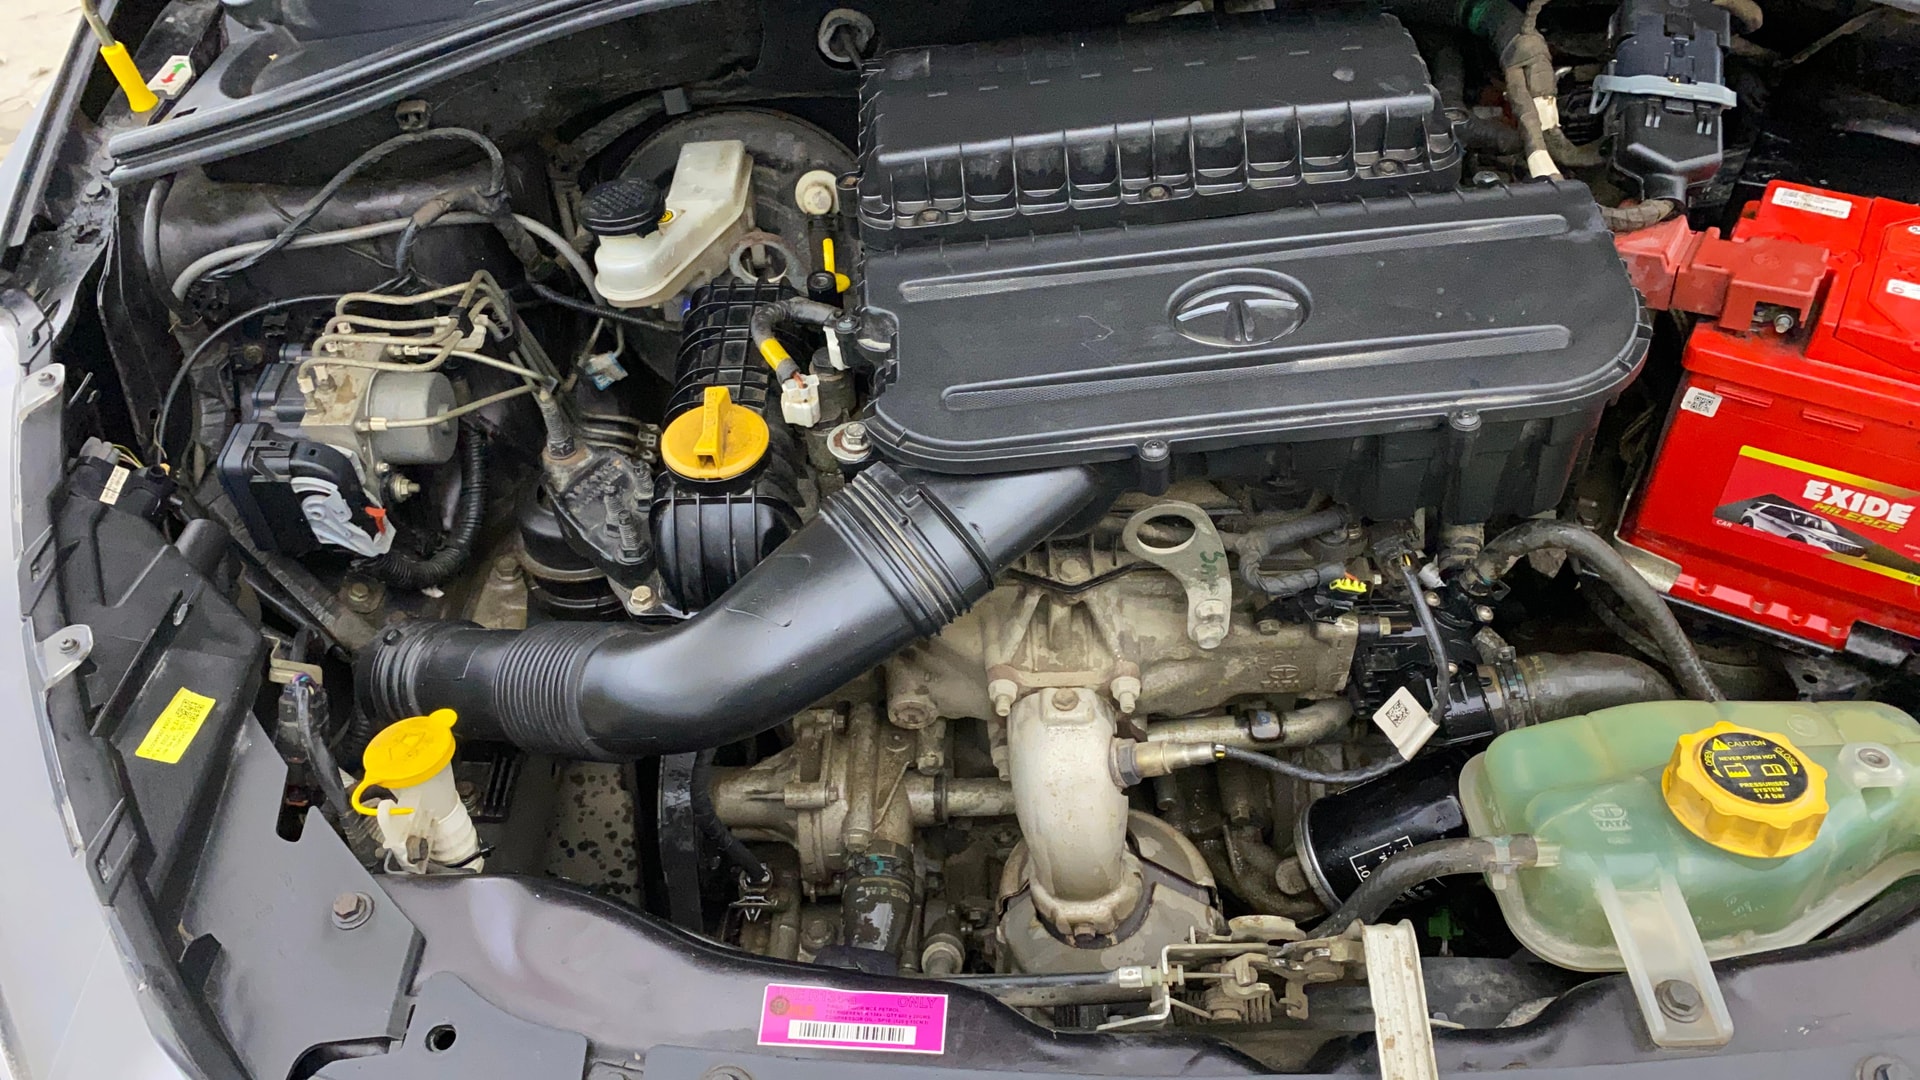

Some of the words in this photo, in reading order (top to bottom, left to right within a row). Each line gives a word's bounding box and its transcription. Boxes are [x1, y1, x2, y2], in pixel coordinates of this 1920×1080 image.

[1802, 480, 1916, 524] EXIDE
[1715, 519, 1733, 528] CAR
[1811, 502, 1905, 532] MILEAGE
[1727, 739, 1766, 747] CAUTION
[1705, 750, 1714, 767] OPEN
[1774, 747, 1799, 767] CLOSE
[897, 995, 938, 1009] ONLY
